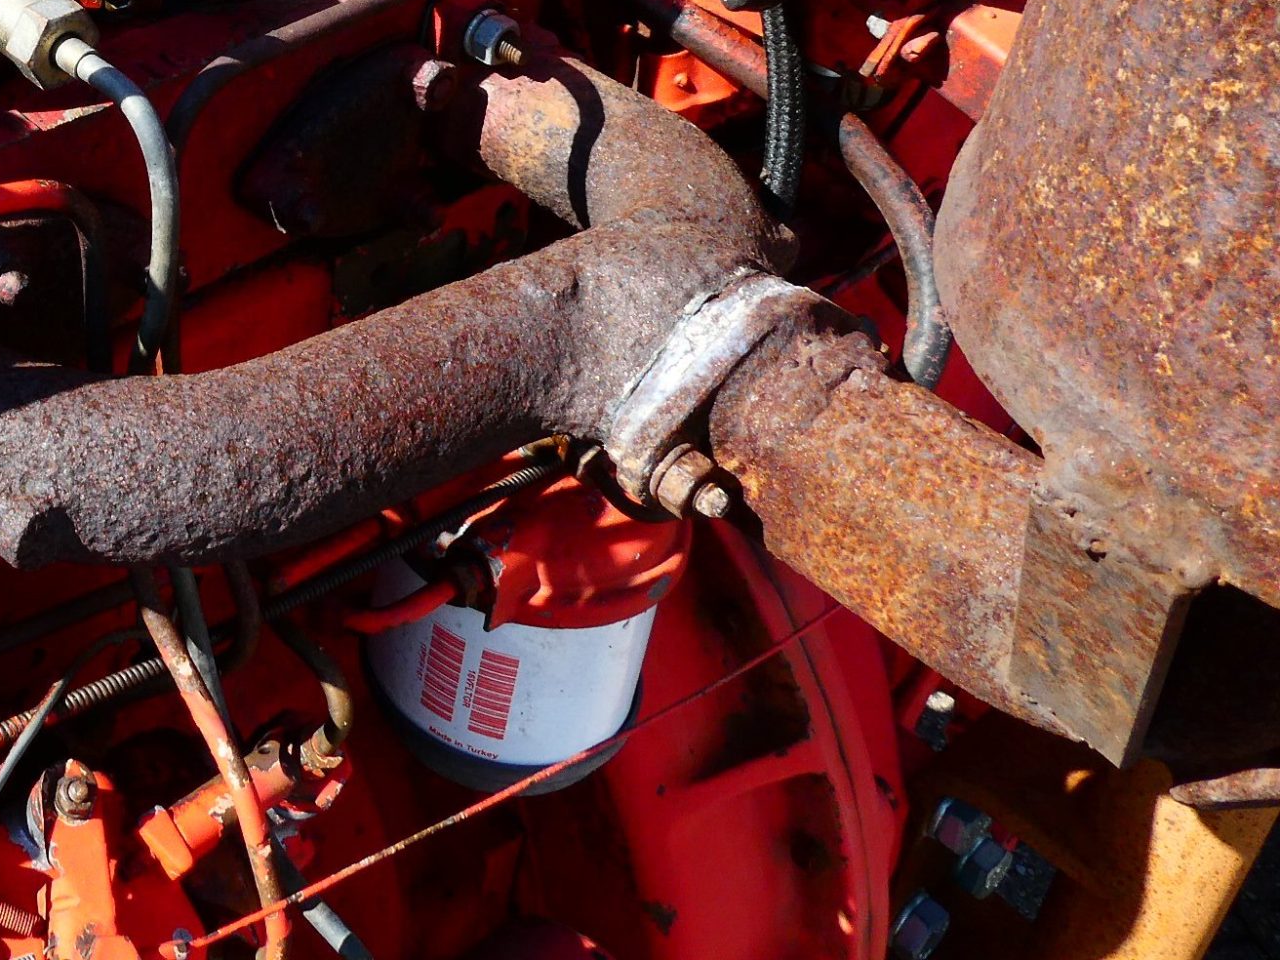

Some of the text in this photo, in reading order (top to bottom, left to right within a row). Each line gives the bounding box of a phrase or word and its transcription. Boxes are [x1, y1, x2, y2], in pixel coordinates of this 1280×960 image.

[429, 725, 499, 760] Made in Turkey
